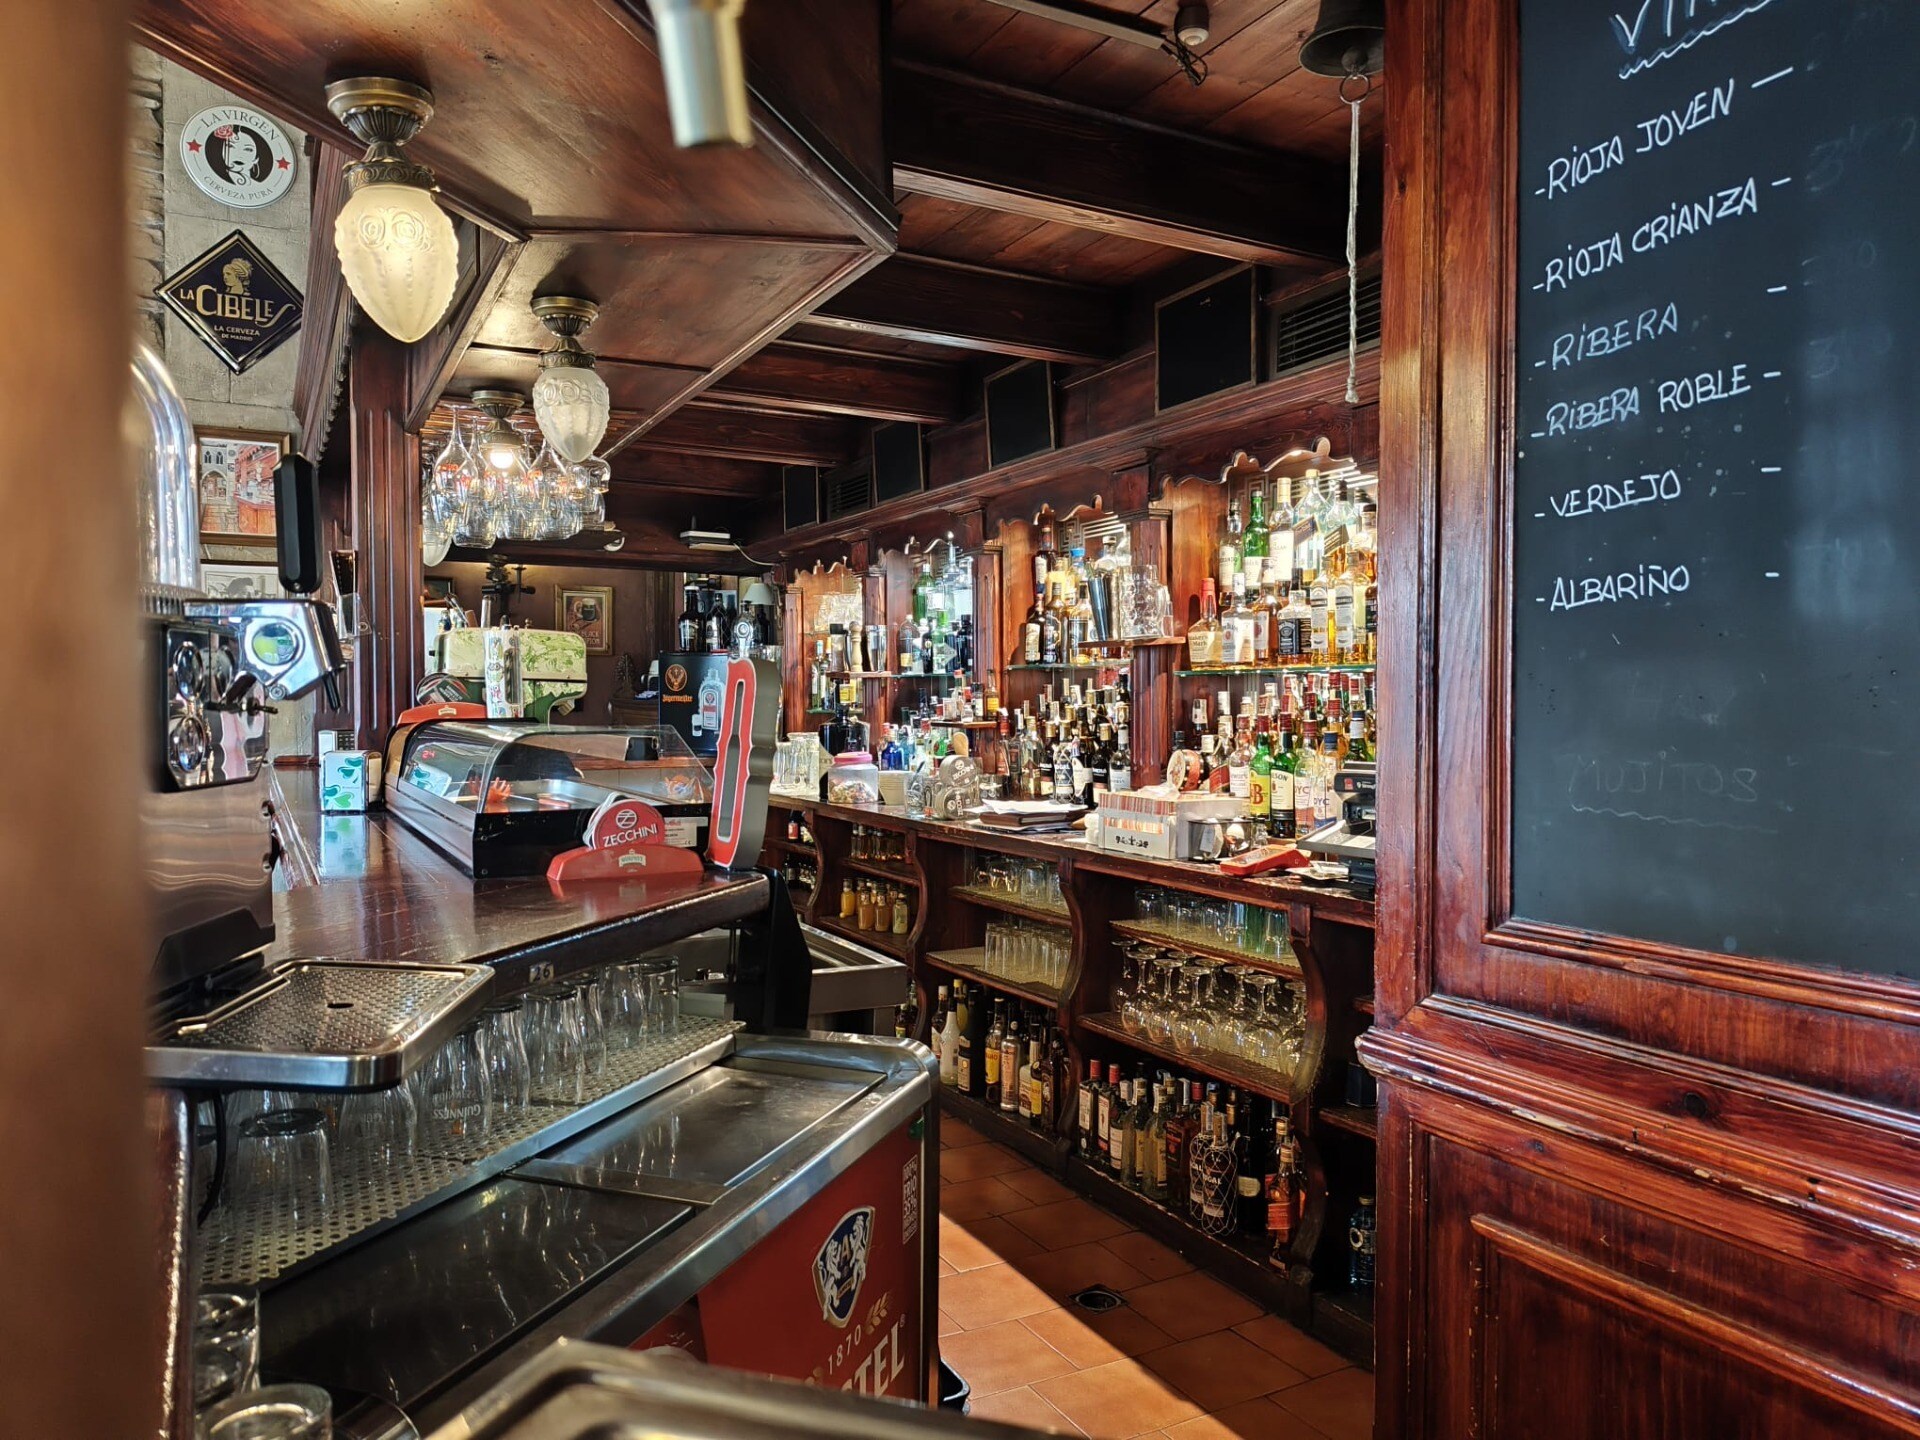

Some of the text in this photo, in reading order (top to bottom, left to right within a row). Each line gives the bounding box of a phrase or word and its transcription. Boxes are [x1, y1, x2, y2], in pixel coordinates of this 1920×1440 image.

[201, 110, 279, 141] LA VIRGEN
[1636, 78, 1734, 152] JOVEN
[204, 176, 273, 200] CERVEZA PURA
[1632, 177, 1757, 252] CRIANZA
[180, 288, 195, 300] LA
[227, 326, 260, 336] CERVEZA
[1658, 364, 1751, 413] ROBLE
[603, 823, 658, 848] ZECCHINI
[433, 1103, 481, 1119] GUINNESS
[828, 1324, 861, 1375] 1870
